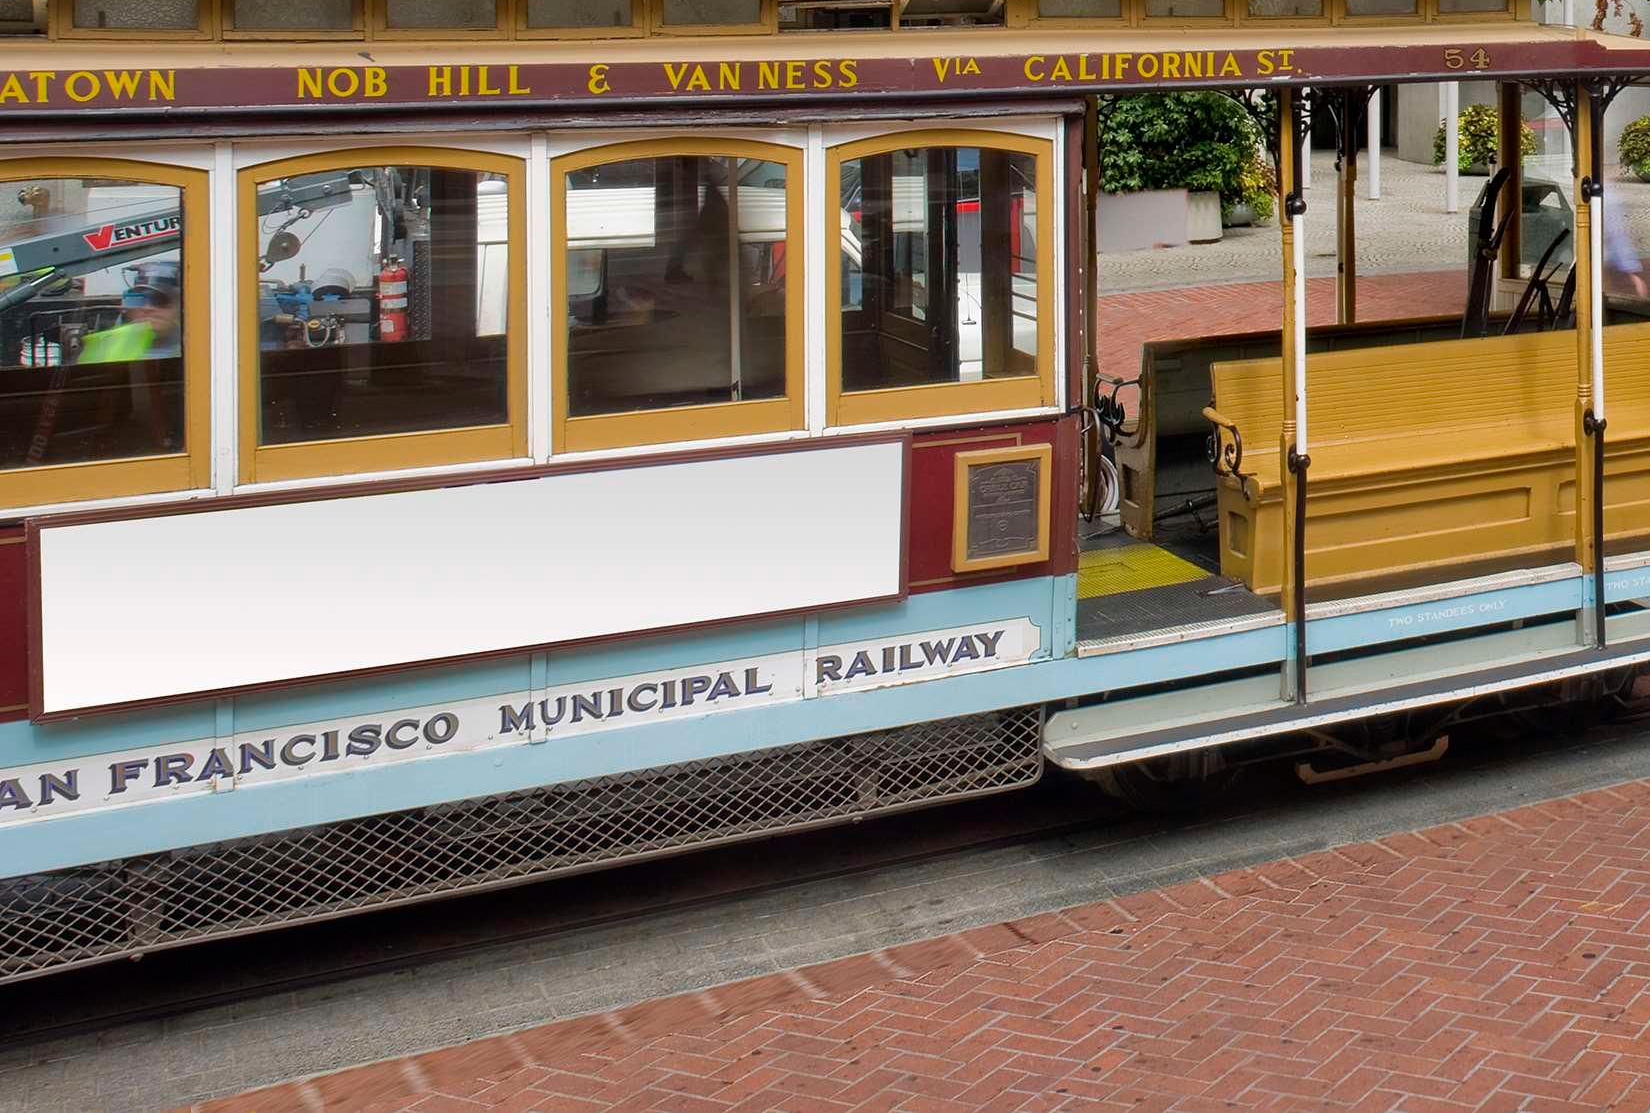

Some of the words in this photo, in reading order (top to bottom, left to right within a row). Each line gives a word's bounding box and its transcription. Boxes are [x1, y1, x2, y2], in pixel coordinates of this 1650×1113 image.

[1443, 47, 1491, 70] 54
[0, 69, 176, 104] ATOWN
[297, 65, 388, 98] NOB
[428, 64, 530, 96] HILL
[588, 62, 610, 95] &
[933, 55, 982, 83] VIA
[1023, 51, 1243, 82] CALIFORNIA
[1604, 582, 1629, 591] TWO
[1388, 616, 1413, 629] TWO
[1417, 605, 1475, 624] STANDEES
[1479, 600, 1507, 613] ONLY
[0, 769, 81, 811] AN
[109, 711, 460, 795] FRANCISCO
[498, 666, 773, 735] MUNICIPAL
[816, 628, 1006, 686] RAILWAY
